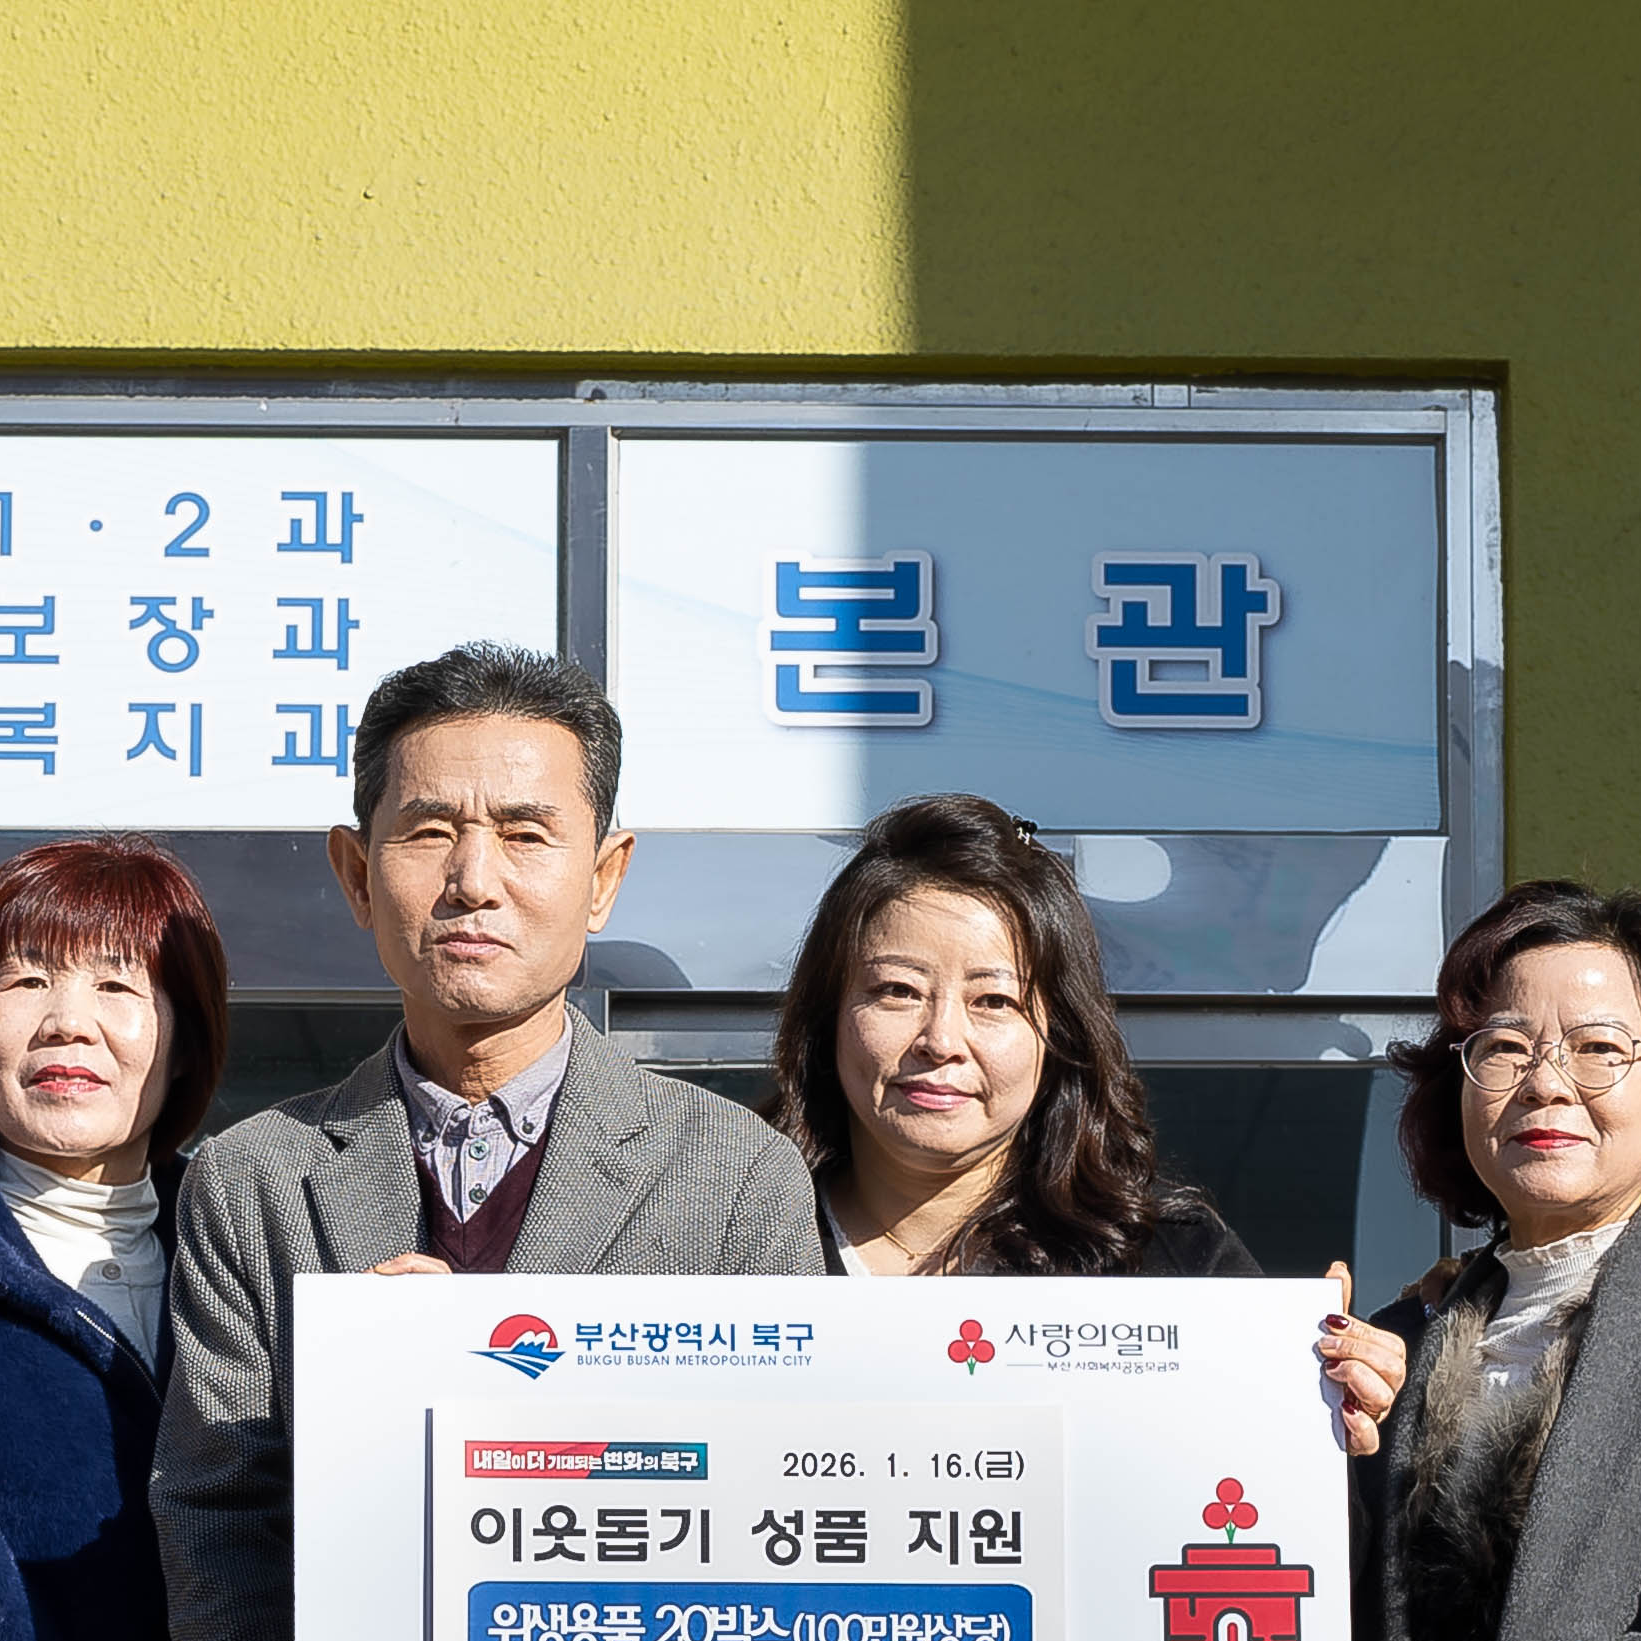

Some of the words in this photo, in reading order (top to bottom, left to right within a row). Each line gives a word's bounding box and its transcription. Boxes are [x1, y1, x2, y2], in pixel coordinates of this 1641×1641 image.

[770, 561, 1268, 716] 본관
[575, 1323, 737, 1351] 부산광역시
[752, 1323, 814, 1351] 북구
[1005, 1323, 1179, 1358] 사랑의열매
[577, 1355, 622, 1366] BUKGU
[627, 1355, 670, 1366] BUSAN
[675, 1355, 777, 1366] METROPOLITAN
[782, 1355, 812, 1366] CITY
[548, 1455, 602, 1470] 기대되는
[604, 1451, 659, 1470] 변화의
[661, 1451, 699, 1472] 북구
[782, 1452, 865, 1478] 2026.
[887, 1452, 909, 1478] 1.
[471, 1505, 710, 1563] 이웃돕기
[752, 1509, 868, 1566] 성품
[908, 1509, 1023, 1565] 지원
